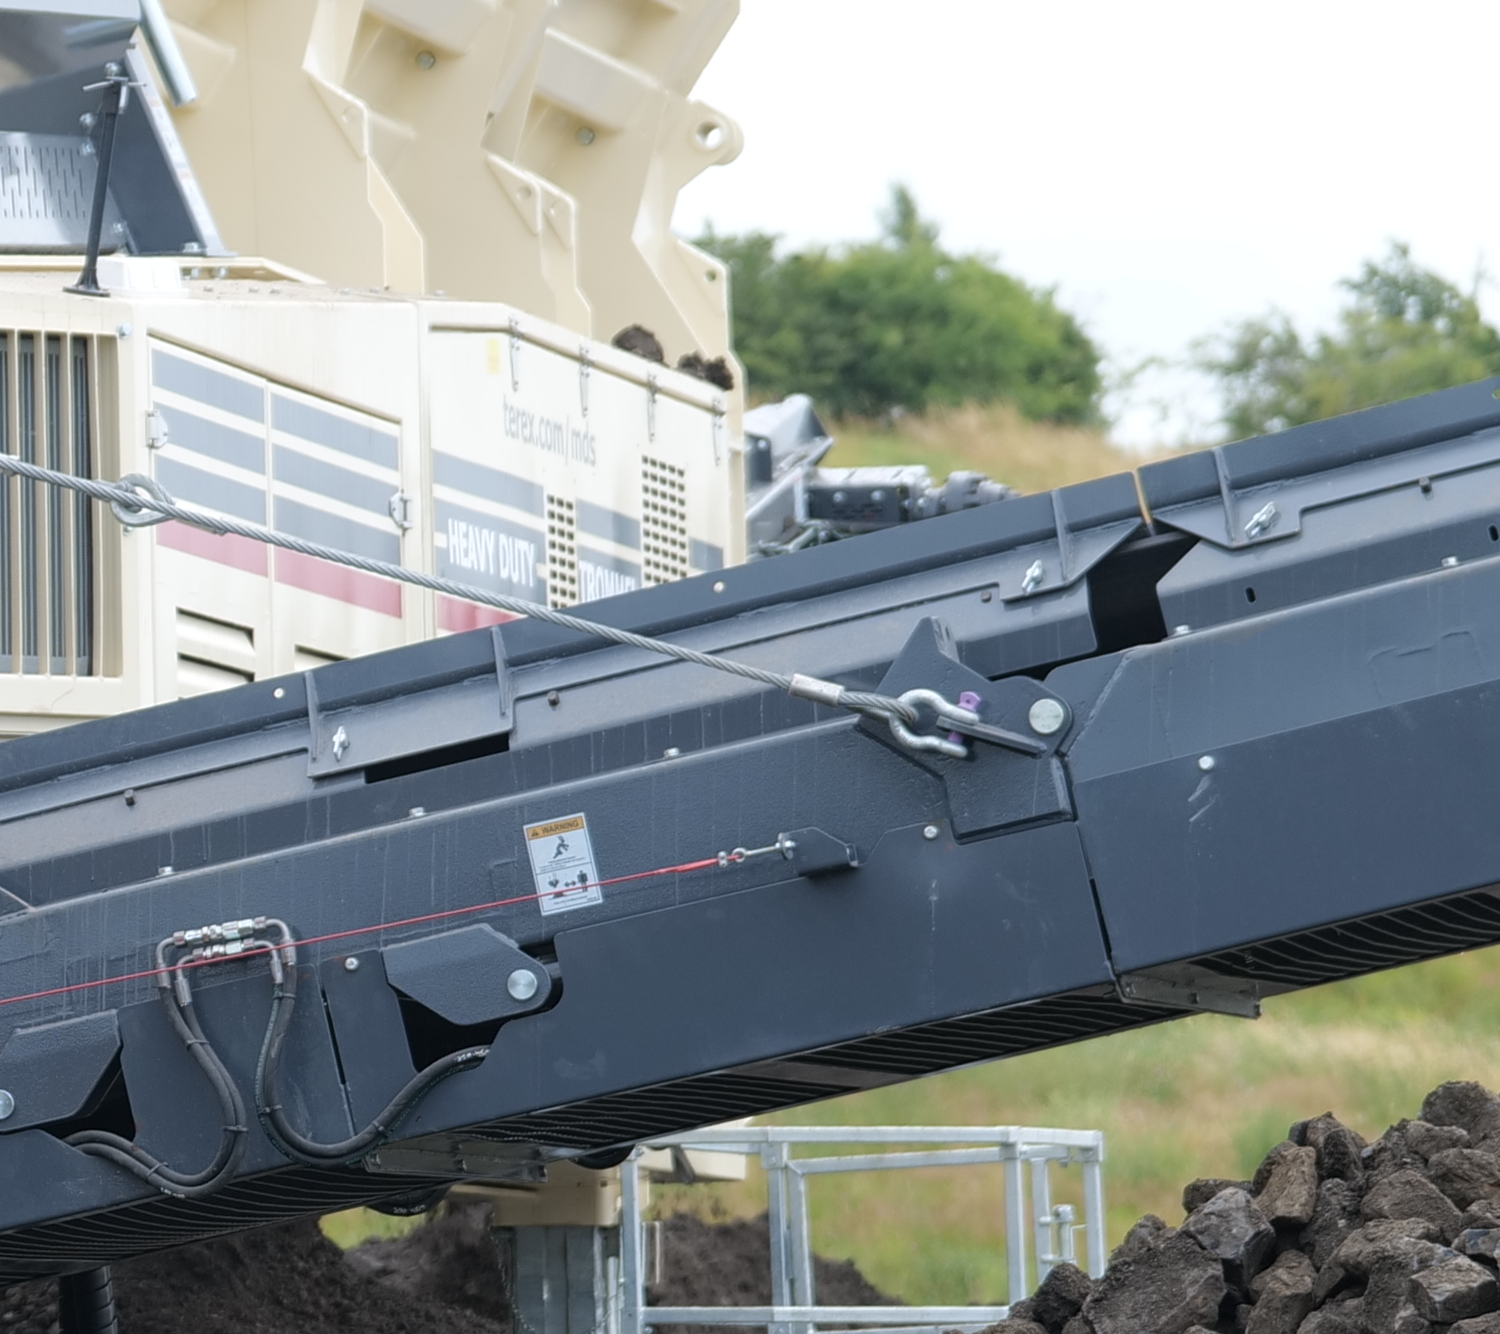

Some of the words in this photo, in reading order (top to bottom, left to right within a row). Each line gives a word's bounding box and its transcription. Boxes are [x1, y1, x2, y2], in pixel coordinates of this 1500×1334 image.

[503, 394, 596, 466] terex.com/mds
[448, 518, 495, 575] HEAVY
[499, 532, 535, 587] DUTY
[541, 820, 579, 834] WARNING
